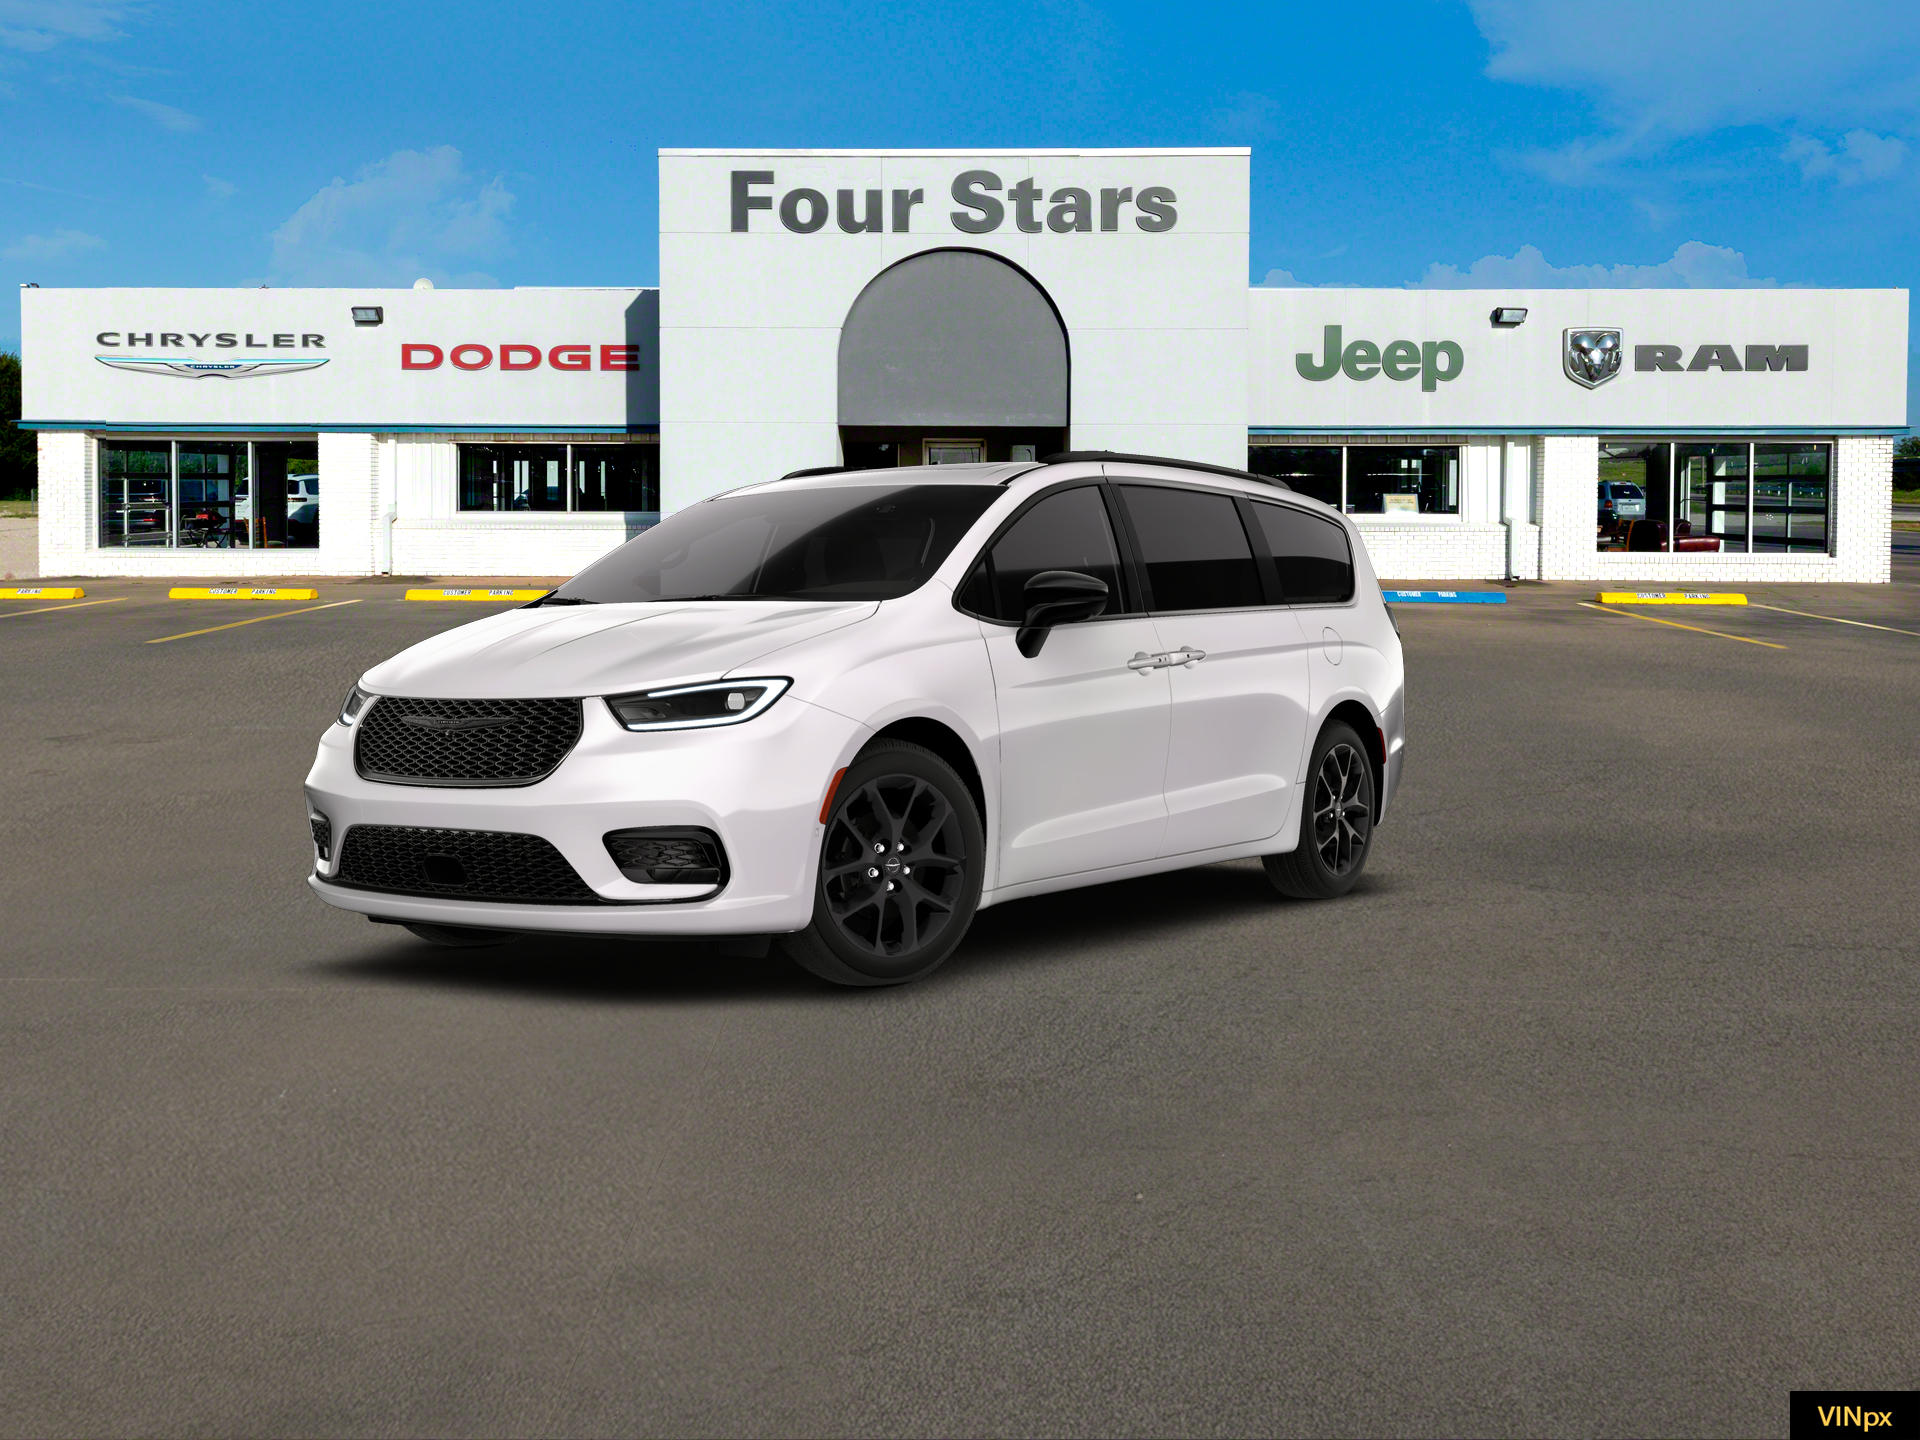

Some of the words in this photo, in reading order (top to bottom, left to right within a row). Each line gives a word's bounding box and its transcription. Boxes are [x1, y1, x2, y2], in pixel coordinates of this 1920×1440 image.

[731, 170, 924, 233] Four
[950, 170, 1178, 233] Stars
[97, 332, 326, 348] CHRYSLER
[401, 343, 640, 371] DODGE
[1296, 324, 1464, 393] Jeep
[1635, 344, 1809, 372] RAM
